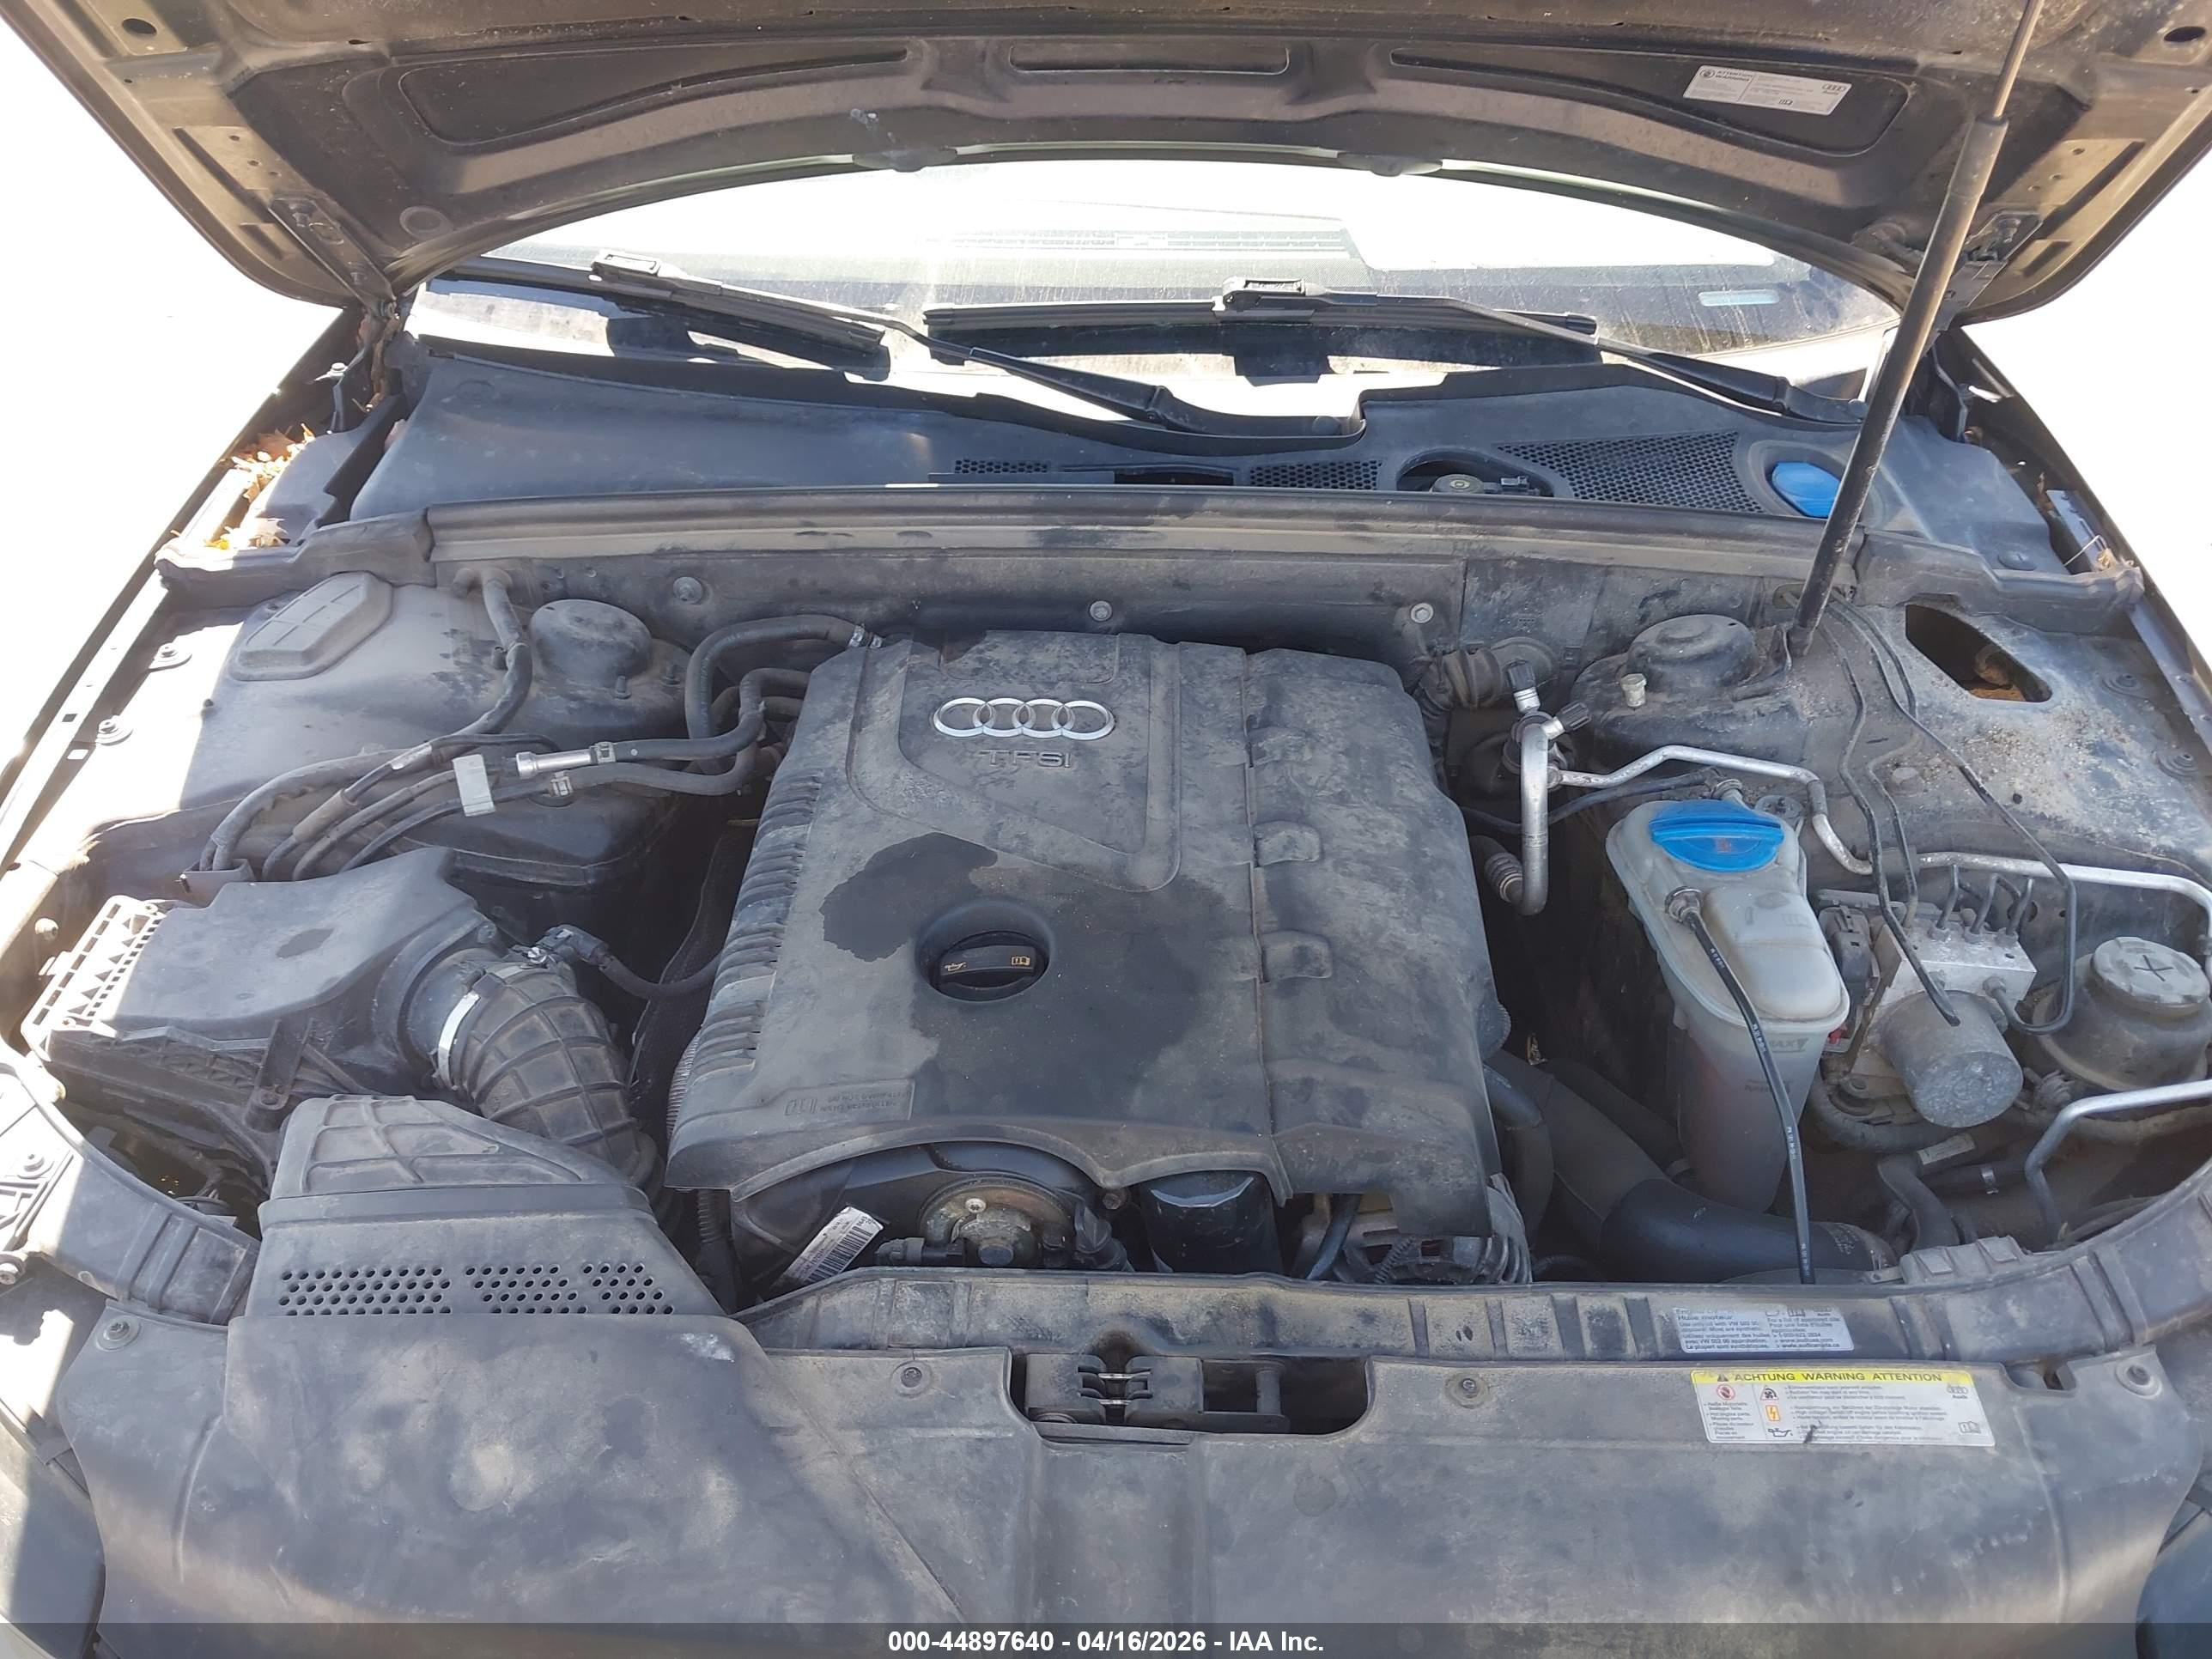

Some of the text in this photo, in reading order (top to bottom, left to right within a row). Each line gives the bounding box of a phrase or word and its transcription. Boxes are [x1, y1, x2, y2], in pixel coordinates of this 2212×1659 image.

[978, 749, 1072, 769] TFSI
[1735, 1372, 1942, 1382] ACHTUNG WARNING ATTENTION
